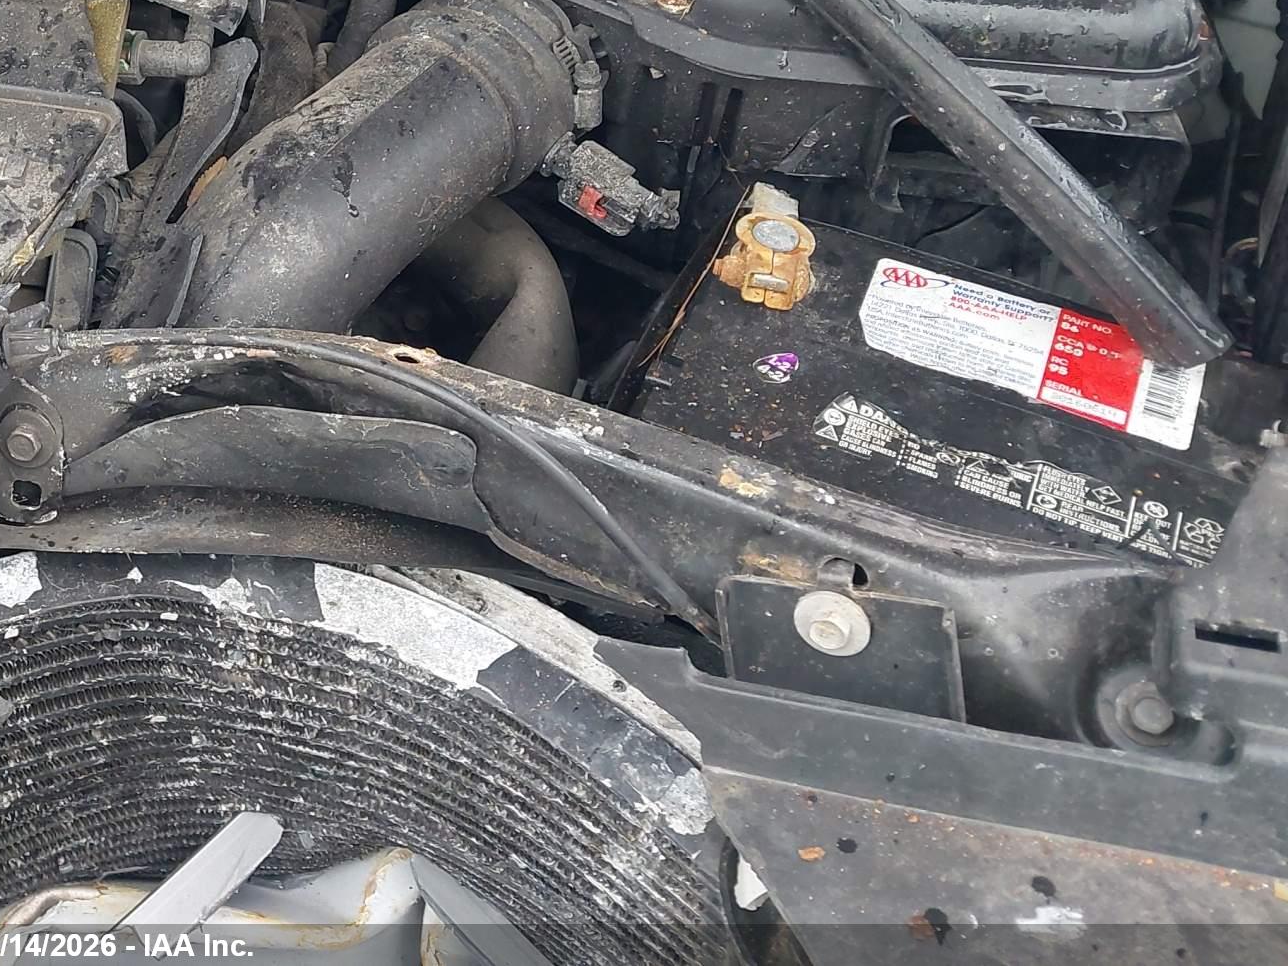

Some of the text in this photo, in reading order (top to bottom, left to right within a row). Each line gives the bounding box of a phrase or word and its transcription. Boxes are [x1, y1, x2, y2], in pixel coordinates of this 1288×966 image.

[887, 268, 924, 288] AAA
[953, 290, 1054, 323] Warranty Support?
[954, 284, 984, 295] Need
[997, 296, 1035, 312] Battery
[948, 302, 1000, 321] AAA.com
[951, 296, 1028, 322] 800-AAA-HELP
[1062, 314, 1090, 329] PART
[1054, 343, 1084, 357] 650
[1057, 335, 1085, 349] CCA
[1048, 364, 1069, 376] 95
[1050, 355, 1069, 366] RC
[1045, 380, 1083, 397] SERIAL
[845, 421, 893, 443] EXPLOSIVE
[848, 414, 900, 439] SHIELD EYES
[841, 434, 897, 458] CAUSE BLINDNESS
[843, 427, 886, 447] GASES CAN
[906, 462, 940, 479] SMOKING
[908, 456, 937, 470] FLAMES
[961, 475, 1009, 496] BLINDNESS
[1008, 490, 1022, 500] OR
[963, 468, 981, 480] CAN
[981, 474, 1009, 489] CAUSE
[1040, 479, 1060, 490] WITH
[1041, 472, 1091, 494] IMMEDIATELY
[1066, 474, 1087, 486] EYES
[959, 481, 992, 498] SEVERE
[1038, 483, 1053, 493] GET
[1052, 488, 1086, 505] MEDICAL
[1085, 499, 1106, 511] HELP
[1060, 500, 1084, 513] READ
[1032, 506, 1045, 516] DO
[1045, 510, 1063, 522] NOT
[1079, 522, 1102, 535] KEEP
[1101, 531, 1124, 543] VENT
[1155, 518, 1173, 529] OUT
